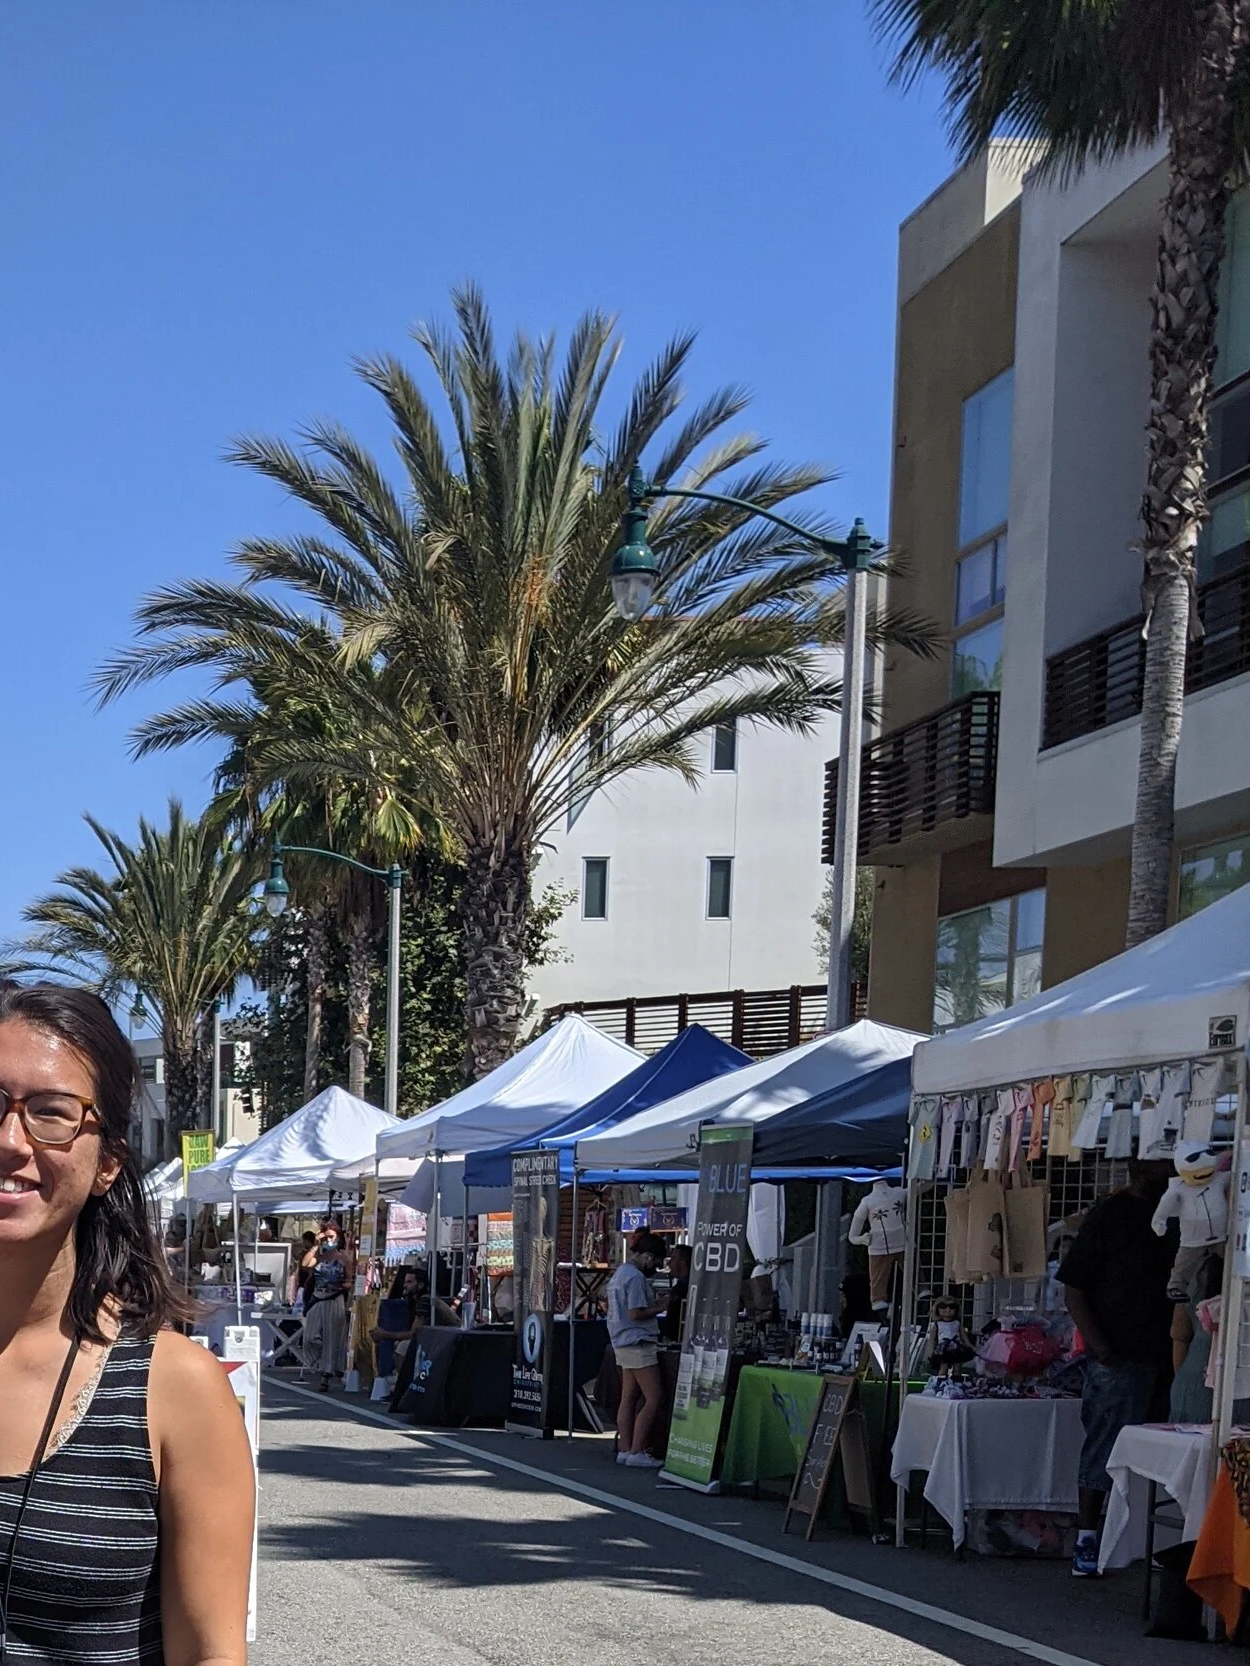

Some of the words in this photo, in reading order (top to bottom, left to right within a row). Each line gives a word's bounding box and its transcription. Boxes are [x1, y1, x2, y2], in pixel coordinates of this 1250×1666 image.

[189, 1149, 210, 1164] PURE
[709, 1164, 747, 1193] BLUE
[698, 1222, 728, 1237] POWER
[729, 1224, 743, 1237] OF
[693, 1241, 740, 1273] CBD
[822, 1393, 844, 1415] CBD
